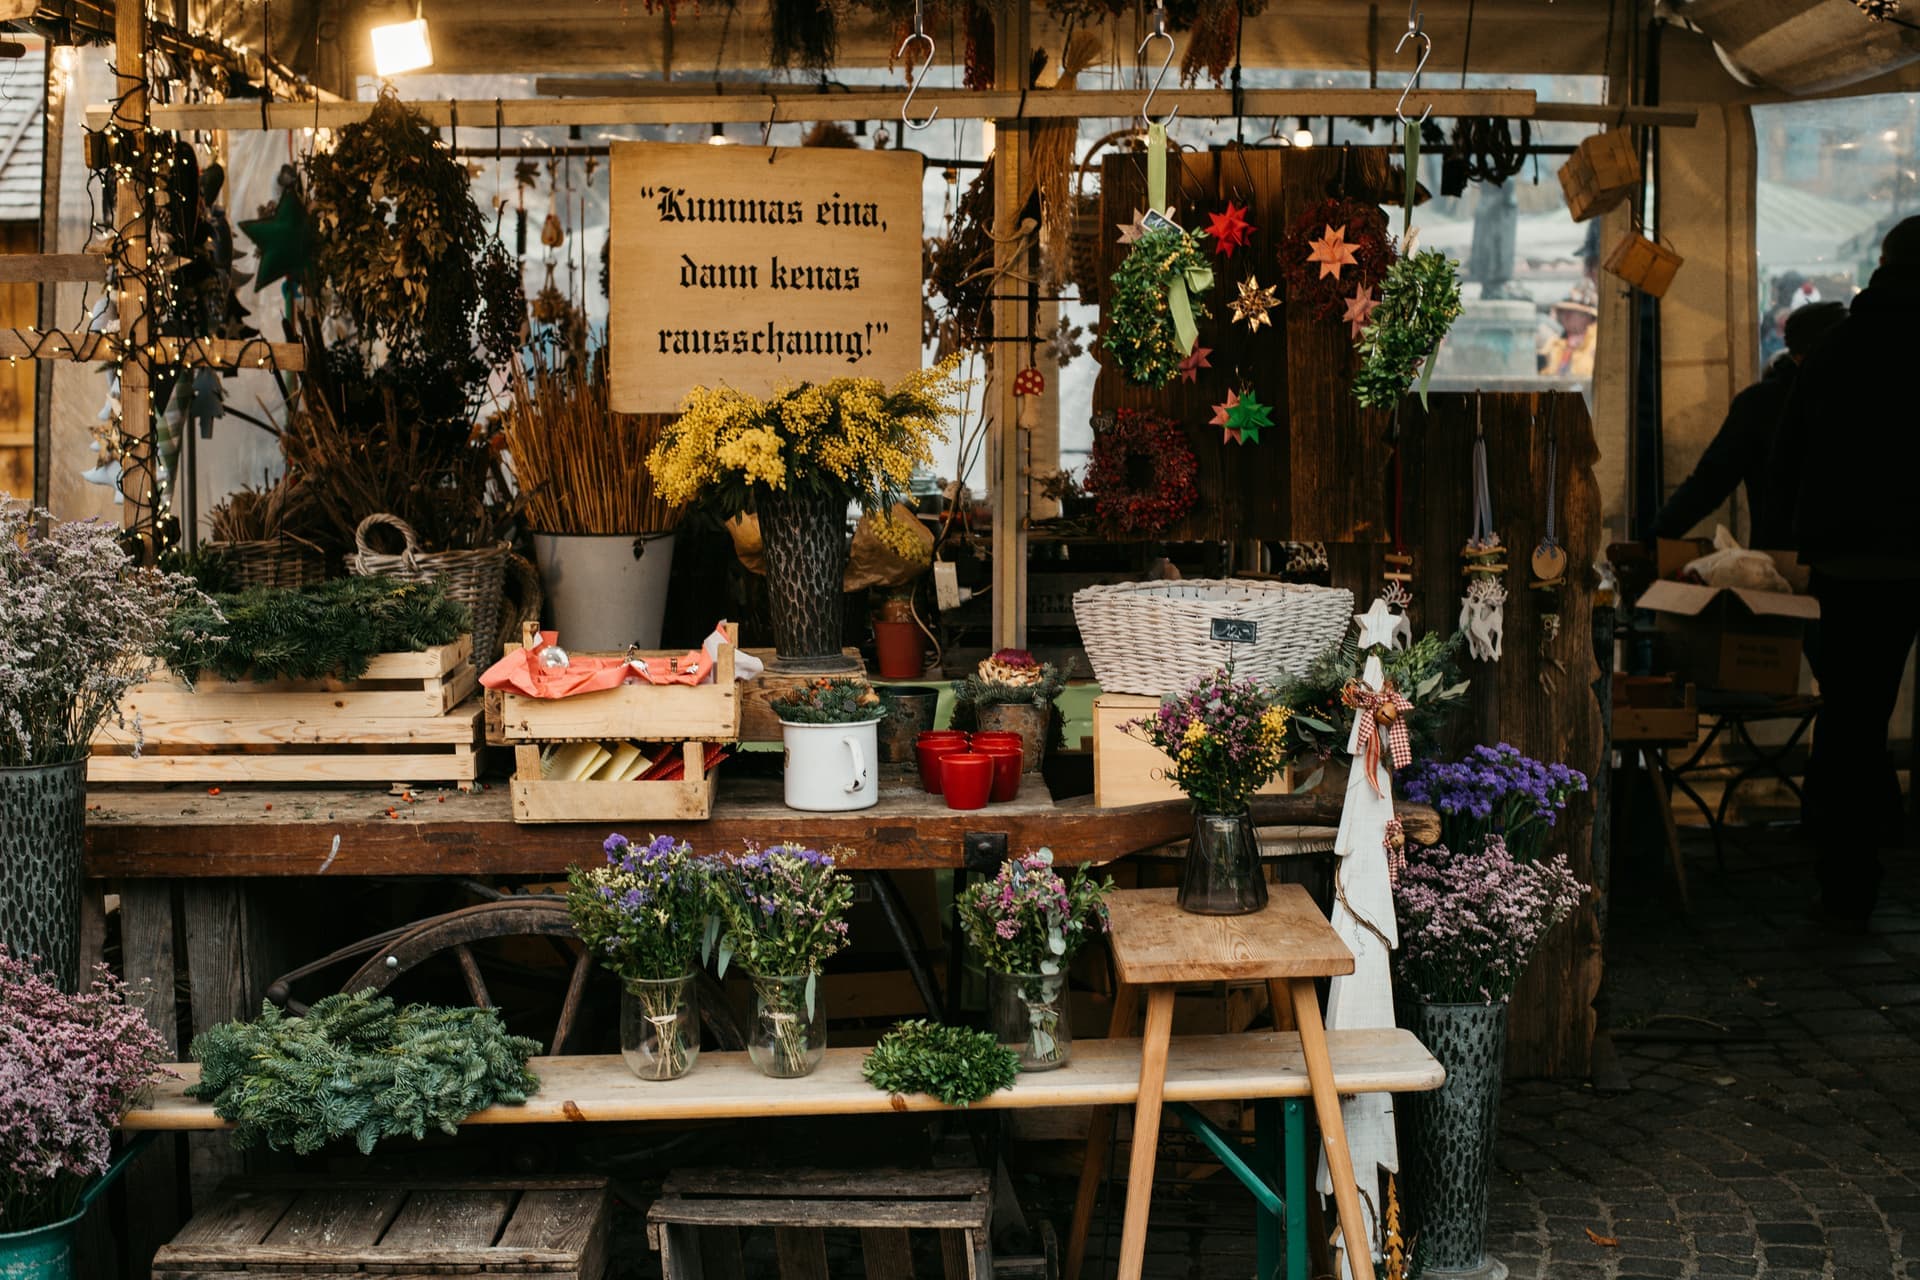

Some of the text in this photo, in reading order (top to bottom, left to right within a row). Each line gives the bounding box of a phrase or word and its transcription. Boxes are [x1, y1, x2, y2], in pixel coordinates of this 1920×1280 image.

[815, 191, 887, 233] eina,
[679, 253, 860, 291] dann kenas
